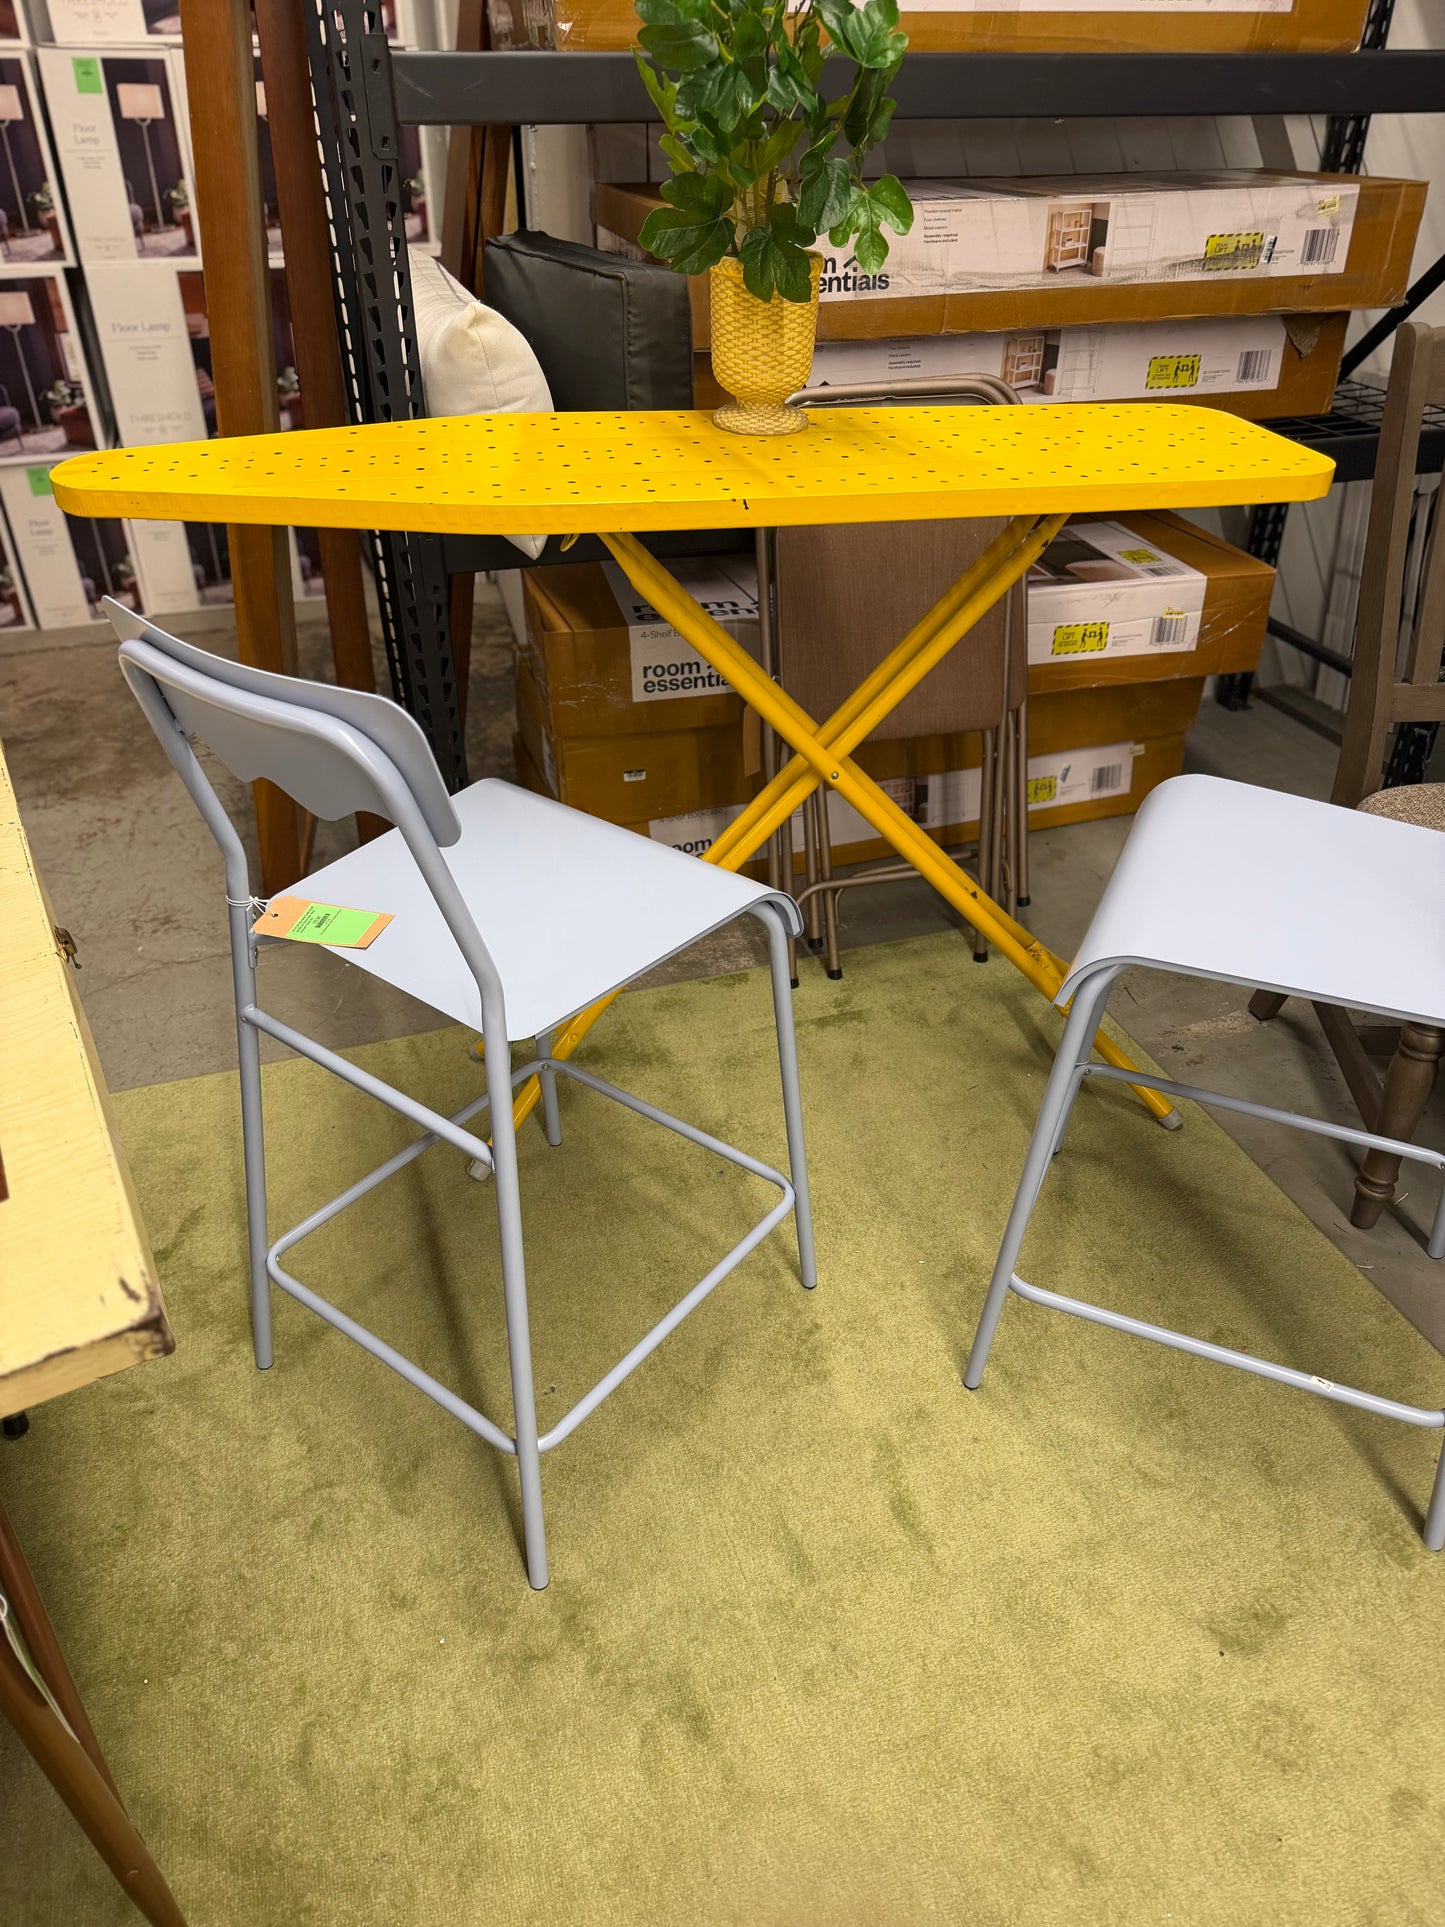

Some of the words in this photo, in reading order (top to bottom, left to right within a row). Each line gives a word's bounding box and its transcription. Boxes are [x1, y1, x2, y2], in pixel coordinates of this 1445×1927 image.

[818, 266, 890, 293] entials
[640, 629, 673, 639] 4-Shelf
[643, 661, 701, 679] room
[643, 671, 729, 693] essentia
